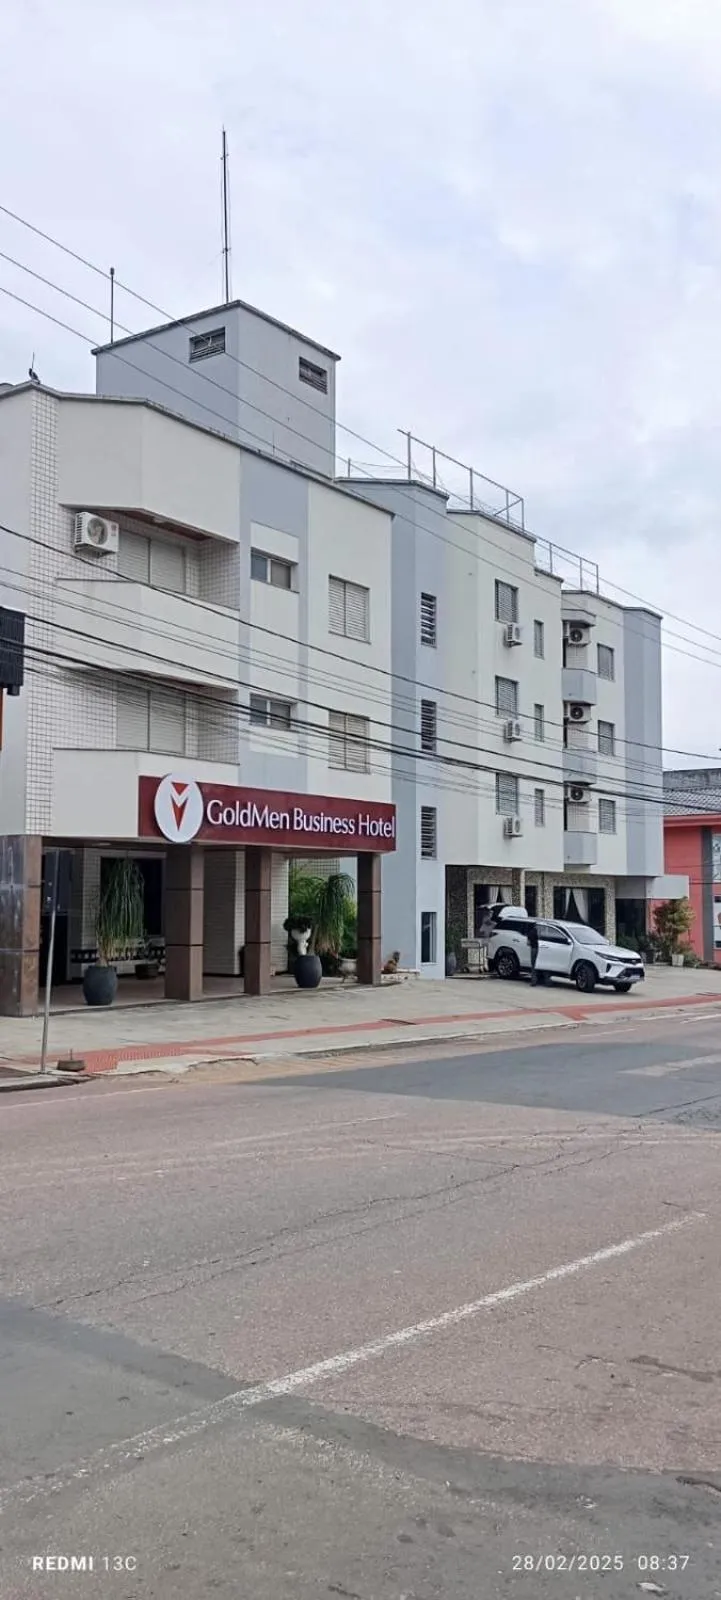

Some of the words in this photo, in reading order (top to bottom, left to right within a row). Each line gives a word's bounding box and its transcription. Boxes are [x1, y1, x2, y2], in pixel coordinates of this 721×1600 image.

[206, 800, 290, 830] GoldMen
[294, 808, 355, 834] Business
[358, 814, 396, 838] Hotel
